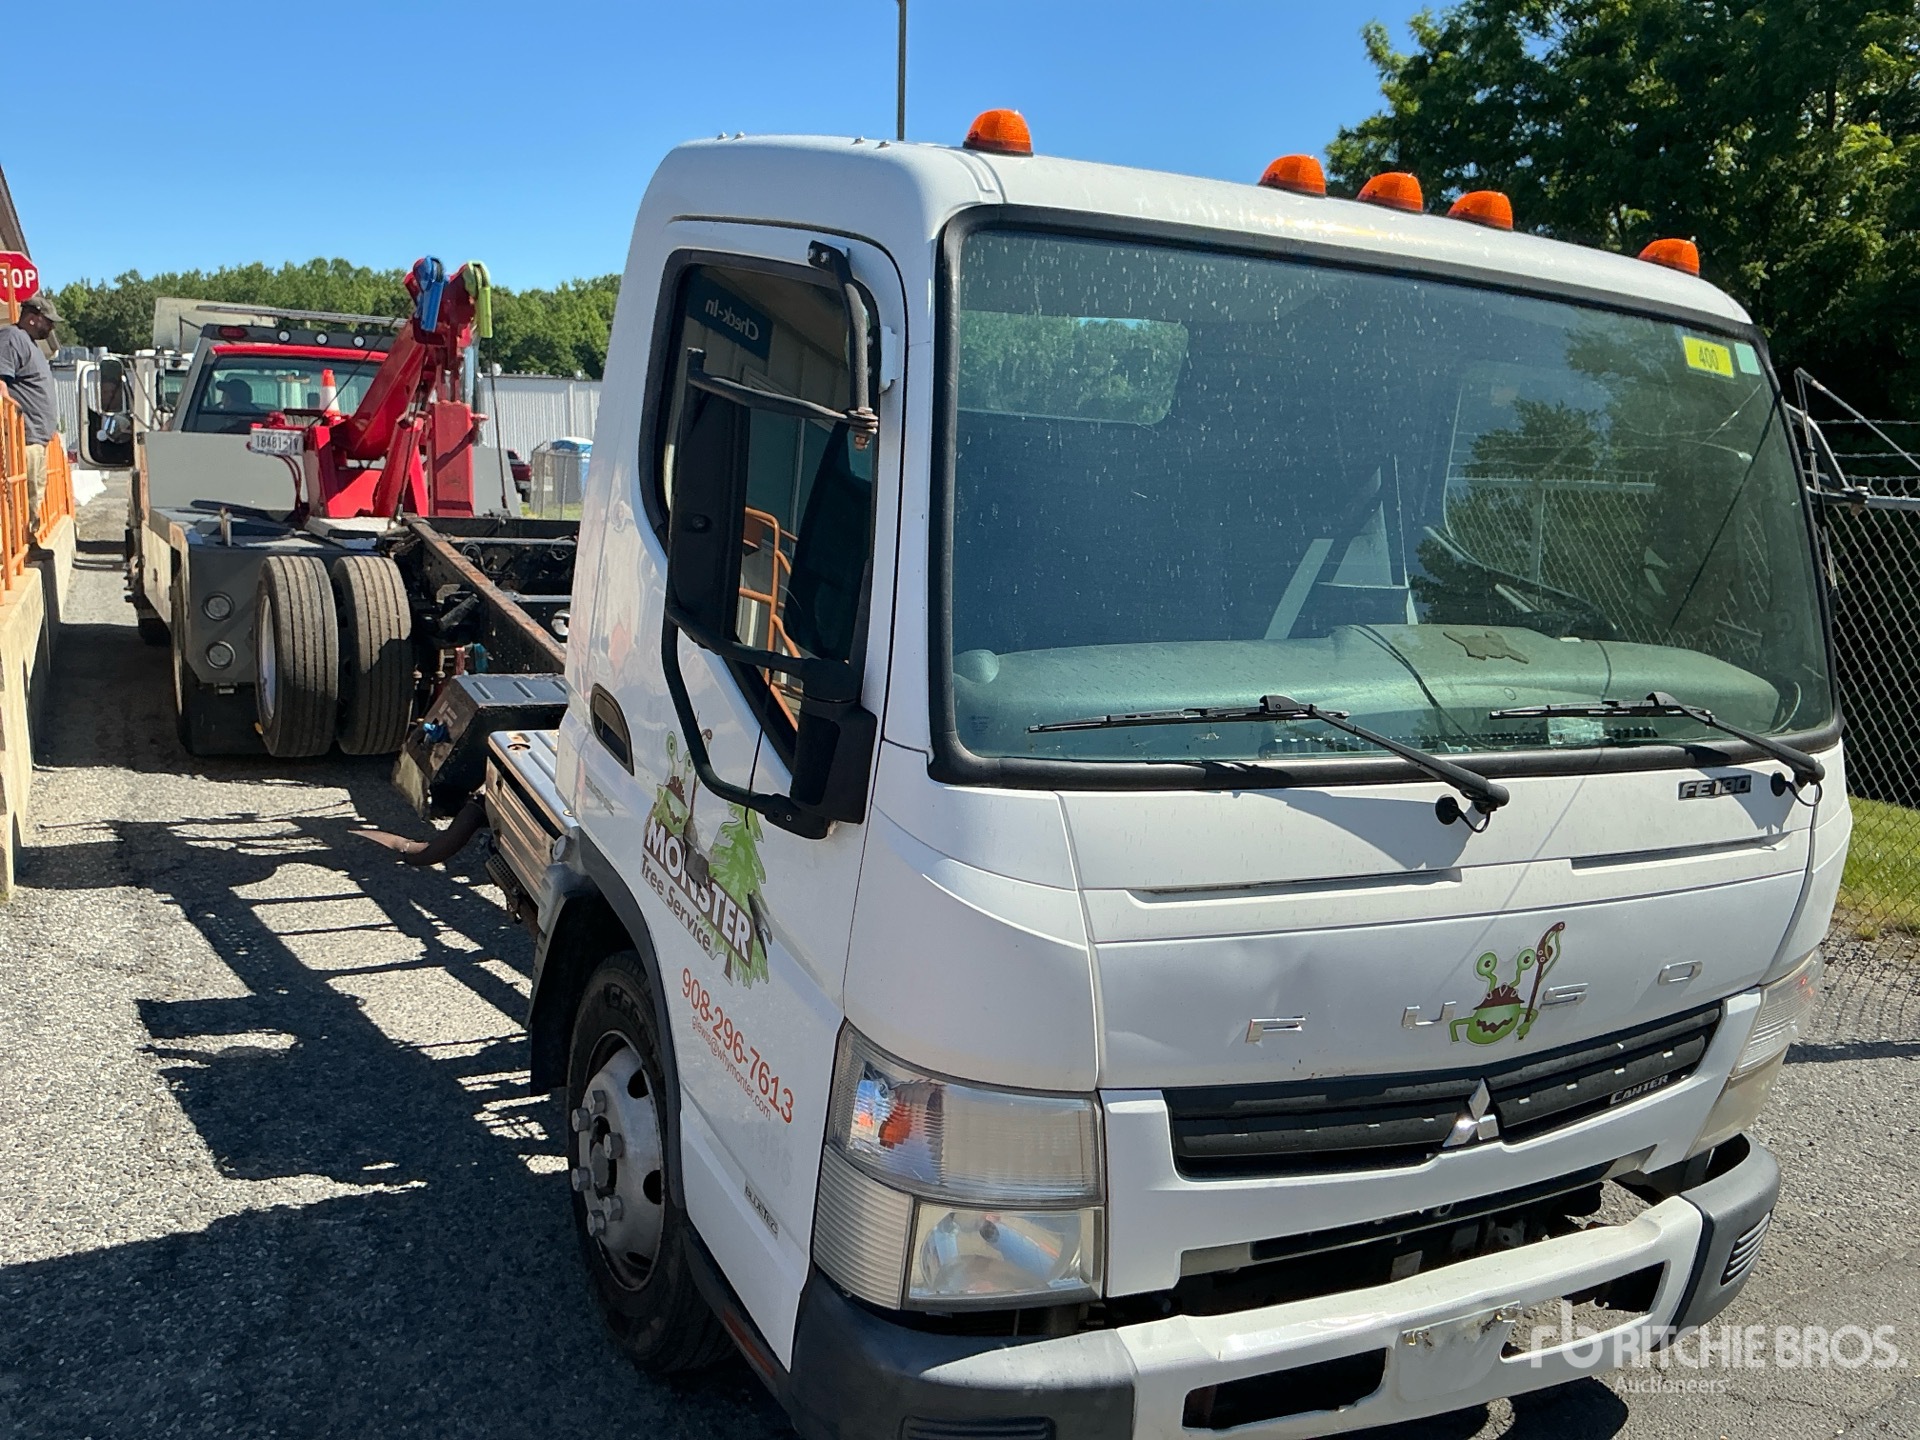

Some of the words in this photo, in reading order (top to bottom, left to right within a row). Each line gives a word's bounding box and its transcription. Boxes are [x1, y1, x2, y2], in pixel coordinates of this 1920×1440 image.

[0, 268, 36, 289] TOP
[1699, 346, 1720, 371] 400
[641, 853, 664, 896] Tree
[666, 886, 711, 951] Service
[682, 967, 794, 1124] 908-296-7613
